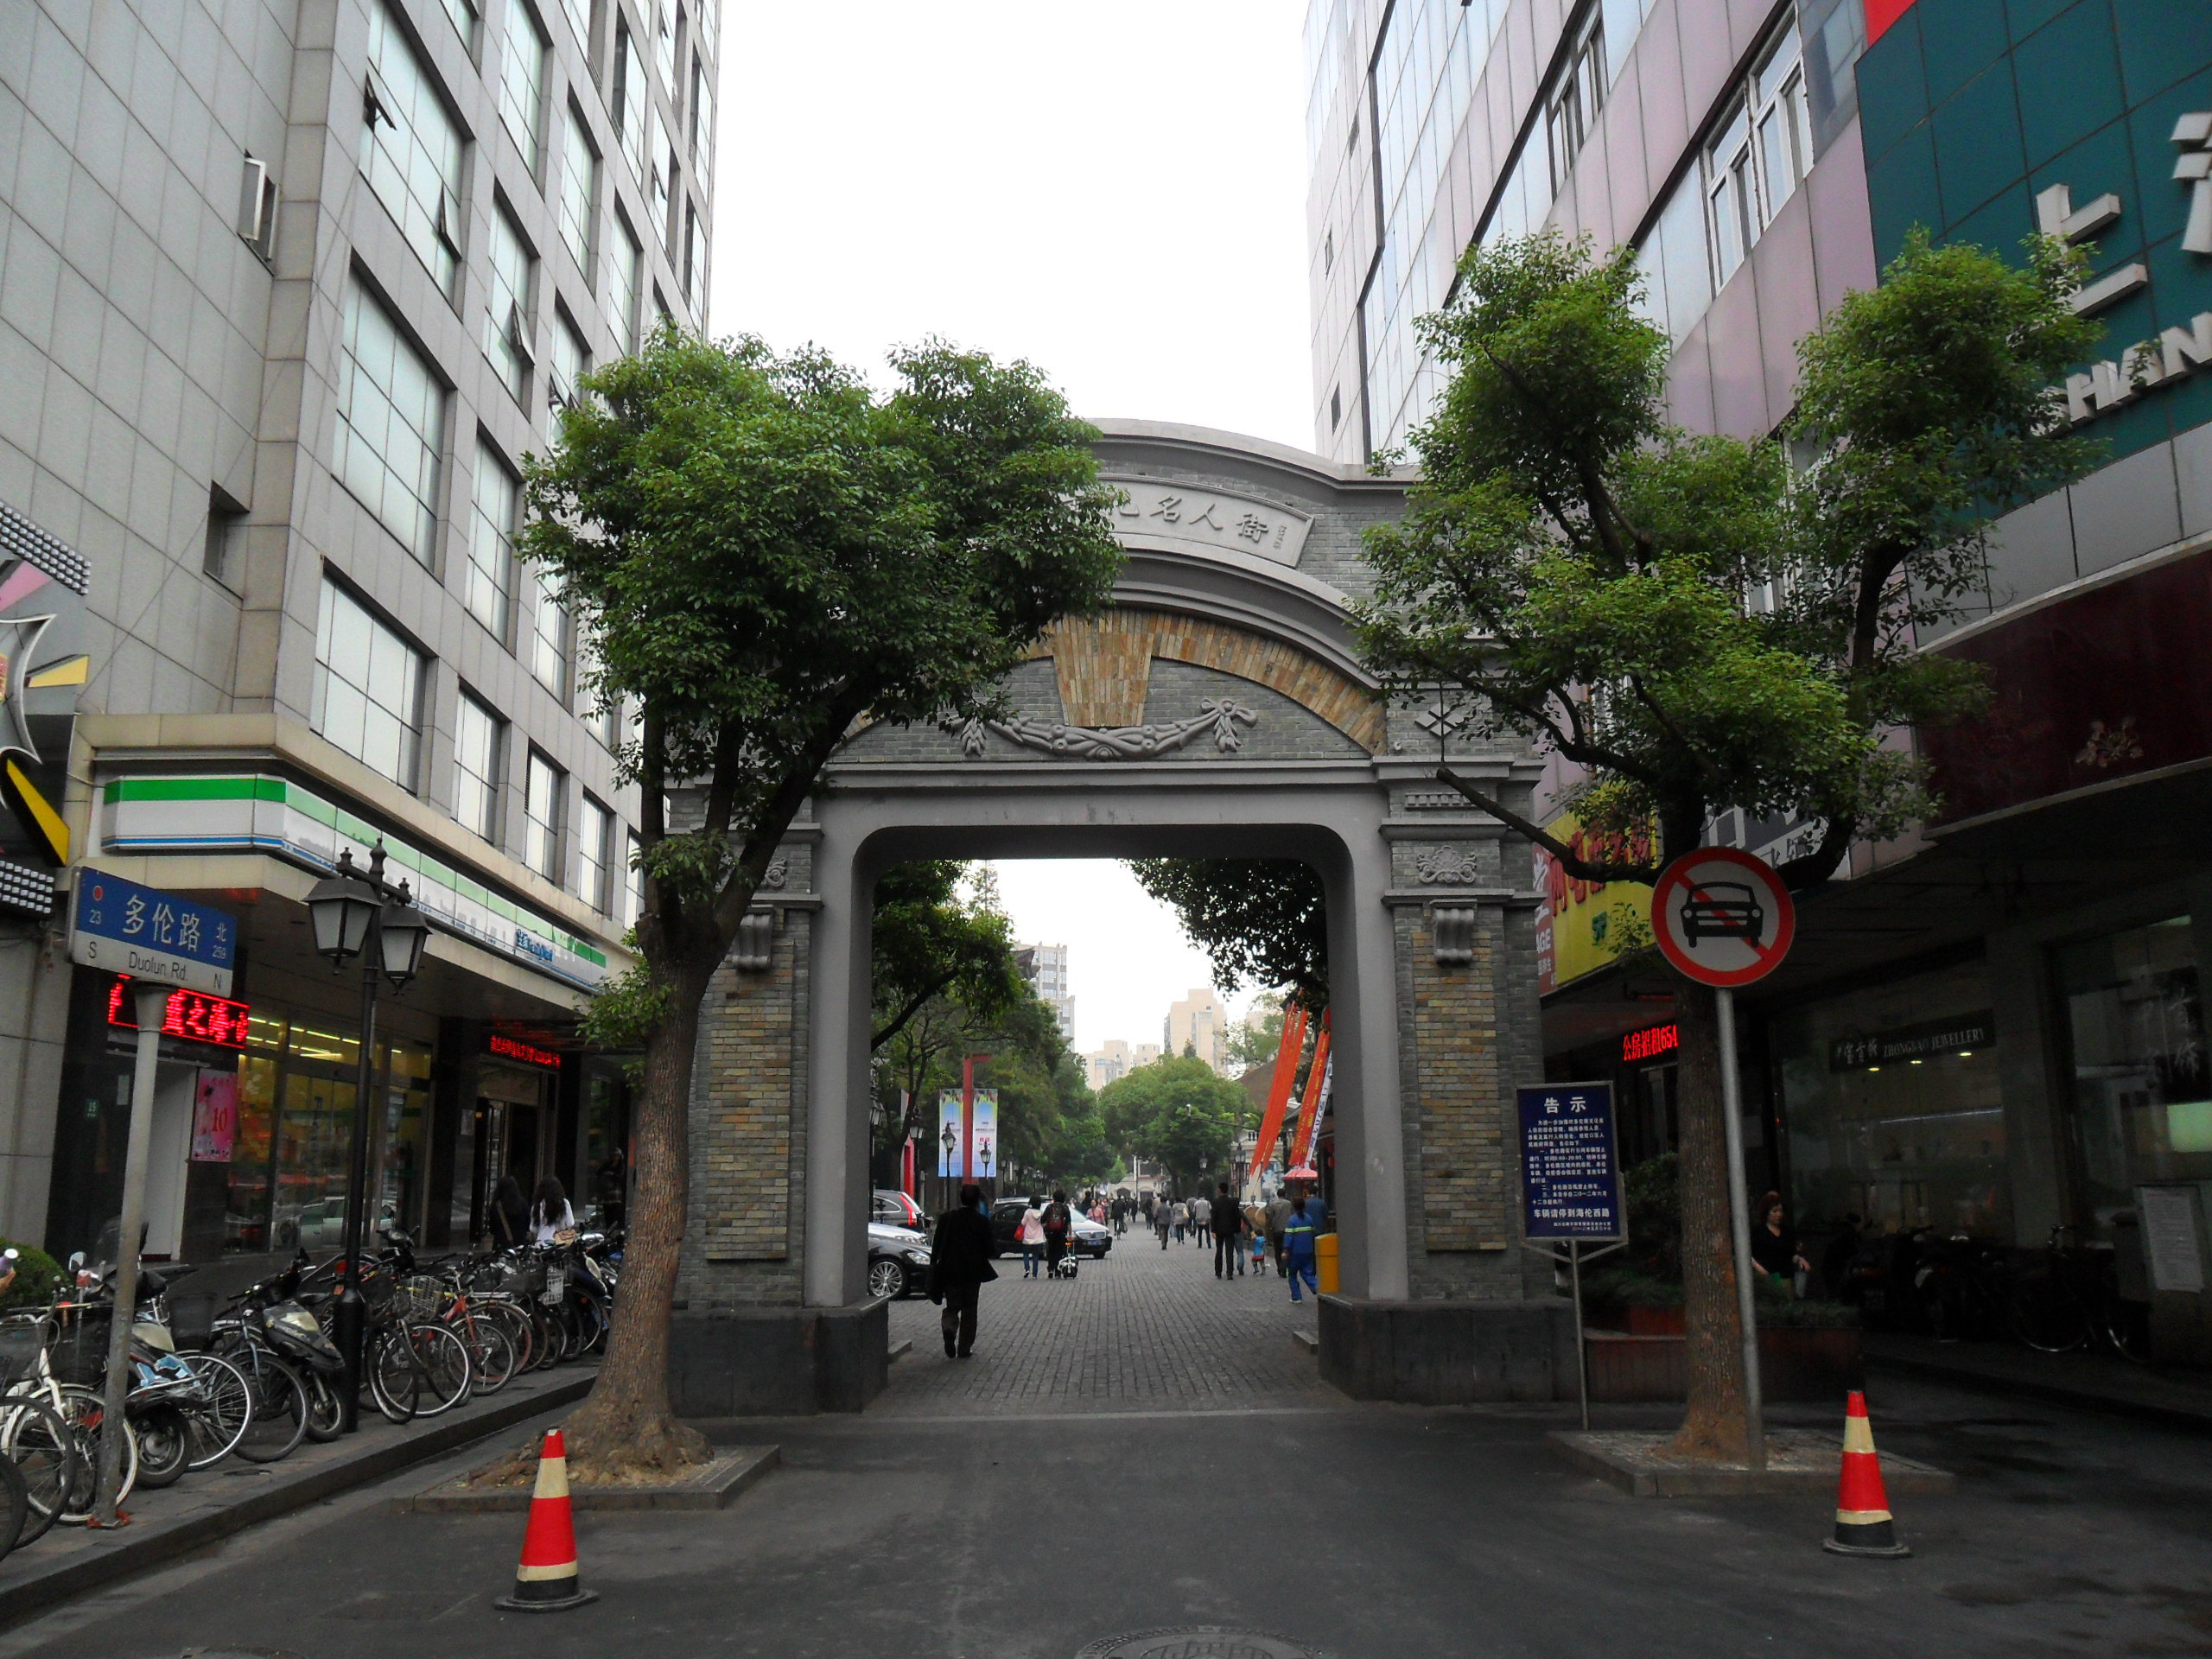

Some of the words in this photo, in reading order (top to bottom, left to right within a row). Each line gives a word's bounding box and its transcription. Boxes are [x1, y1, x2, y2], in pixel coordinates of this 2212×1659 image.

[89, 909, 101, 925] 23
[123, 893, 200, 952] 多伦路
[215, 921, 227, 943] 北
[88, 941, 97, 959] S
[129, 951, 166, 976] Duolun
[172, 962, 188, 982] Rd.
[214, 973, 222, 990] N
[1931, 1027, 1985, 1050] JEWELLERY
[1544, 1096, 1586, 1114] 告示
